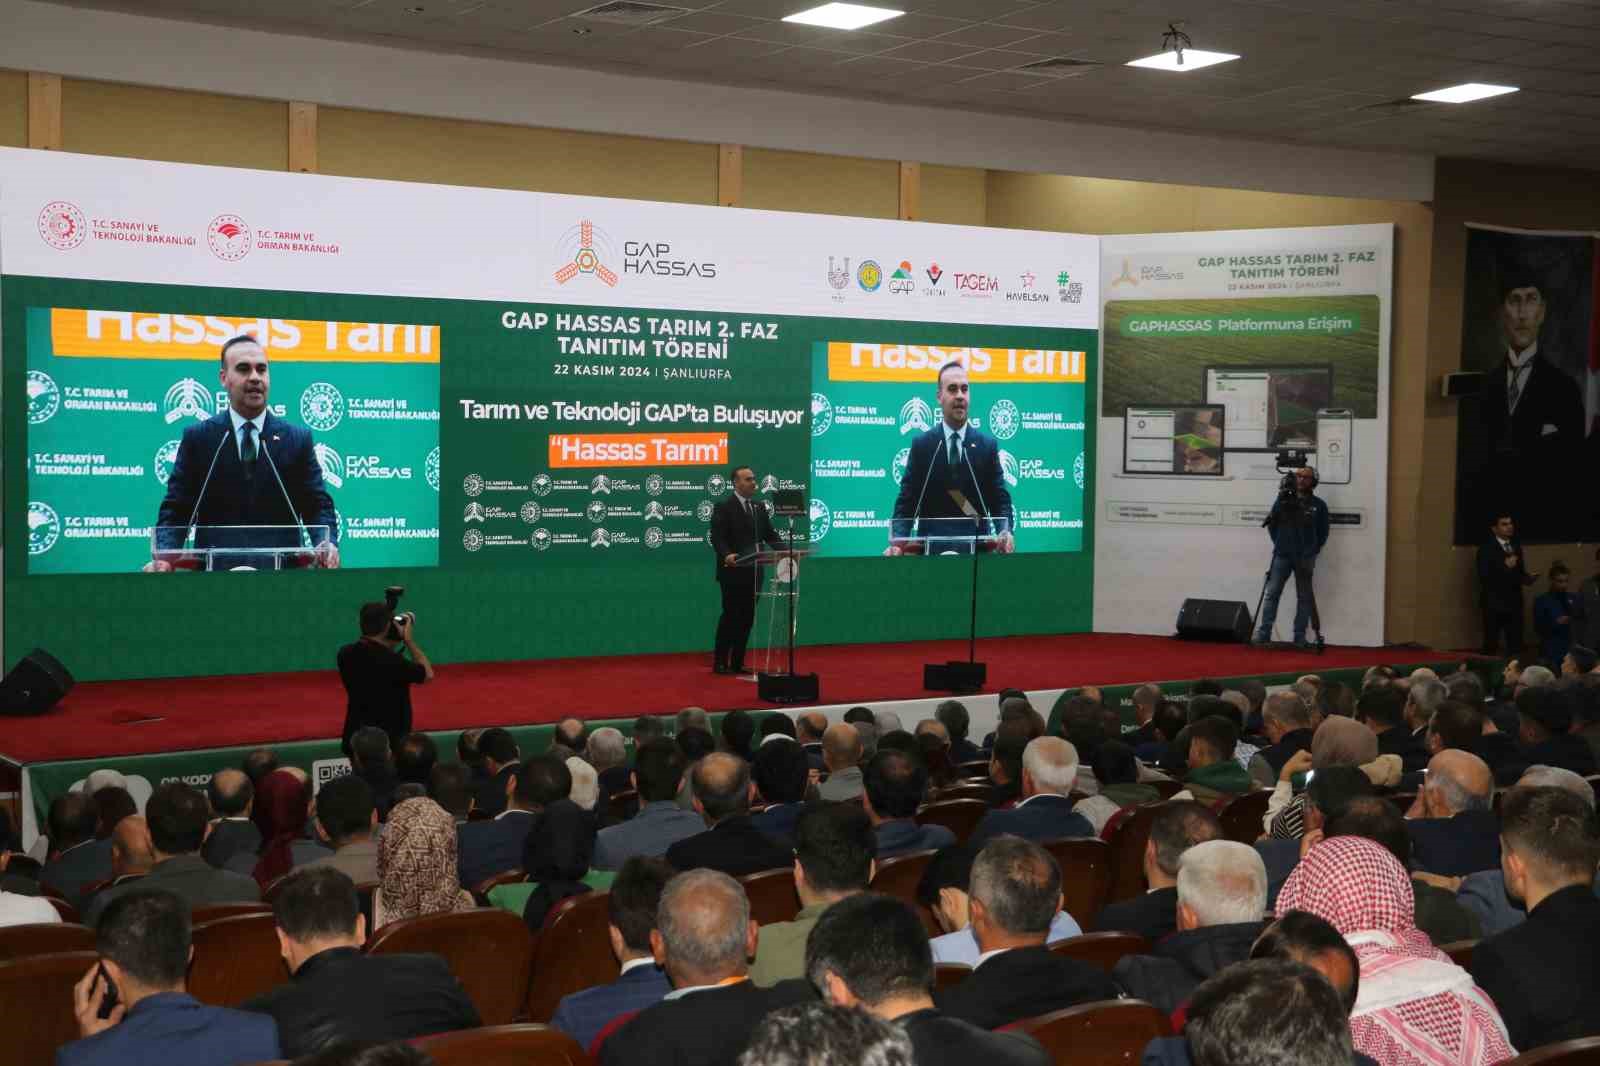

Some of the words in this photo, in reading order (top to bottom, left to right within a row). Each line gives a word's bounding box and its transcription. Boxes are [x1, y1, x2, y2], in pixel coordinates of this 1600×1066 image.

[147, 224, 159, 232] VE
[274, 231, 301, 241] TARIM
[303, 233, 315, 241] VE
[257, 241, 290, 250] ORMAN
[624, 241, 670, 258] GAP
[1198, 256, 1225, 267] GAP
[1229, 254, 1281, 267] HASSAS
[1286, 253, 1328, 265] TARIM
[1332, 253, 1344, 263] 2.
[1348, 251, 1376, 262] FAZ
[624, 258, 716, 278] HASSAS
[1229, 266, 1284, 279] TANITIM
[1288, 264, 1340, 278] TÖRENİ
[953, 273, 999, 291] TAGEM
[1006, 292, 1049, 303] HAVELSAN
[501, 311, 549, 330] GAP
[555, 313, 641, 334] HASSAS
[646, 317, 711, 337] TARIM
[717, 320, 735, 338] 2.
[740, 321, 779, 340] FAZ
[1218, 317, 1305, 332] Platformuna
[1308, 315, 1353, 333] Erişim
[557, 336, 646, 357] TANITIM
[652, 336, 728, 360] TÖRENİ
[554, 364, 569, 375] 22
[574, 365, 615, 376] KASIM
[620, 366, 650, 377] 2024
[663, 367, 732, 380] ŞANLIURFA
[459, 399, 520, 420] Tarım
[523, 403, 549, 420] ve
[552, 400, 641, 427] Teknoloji
[644, 402, 709, 423] GAP'ta
[713, 404, 804, 429] Buluşuyor
[551, 434, 647, 461] “Hassas
[346, 455, 380, 467] GAP
[1019, 459, 1043, 469] GAP
[346, 466, 412, 479] HASSAS
[1019, 468, 1065, 479] HASSAS
